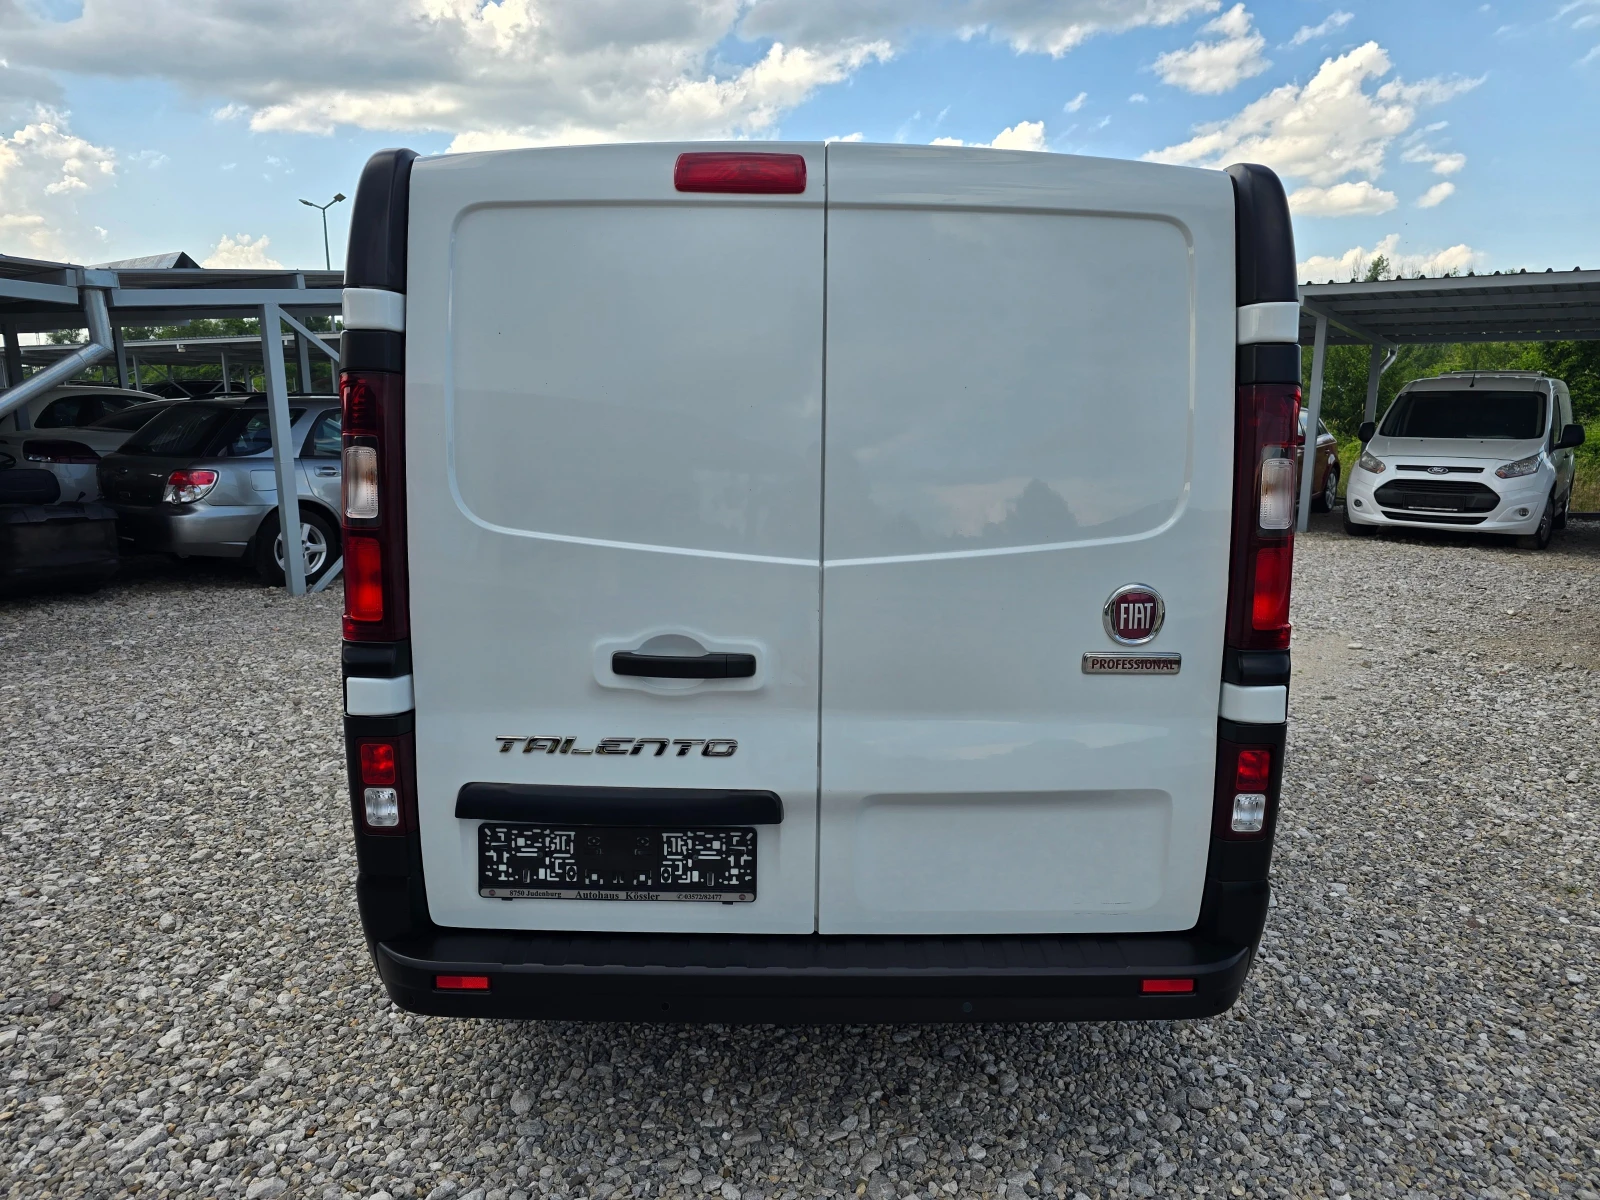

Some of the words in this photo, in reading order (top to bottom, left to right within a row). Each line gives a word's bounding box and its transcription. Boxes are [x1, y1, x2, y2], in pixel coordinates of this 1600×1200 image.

[1120, 602, 1153, 630] FIAT
[1091, 658, 1175, 670] PROFESSIONAL
[495, 735, 738, 757] TALENTO
[509, 889, 524, 897] 8750
[525, 890, 562, 898] Judenburg
[575, 890, 619, 899] Autohaus
[625, 891, 660, 900] Kössler
